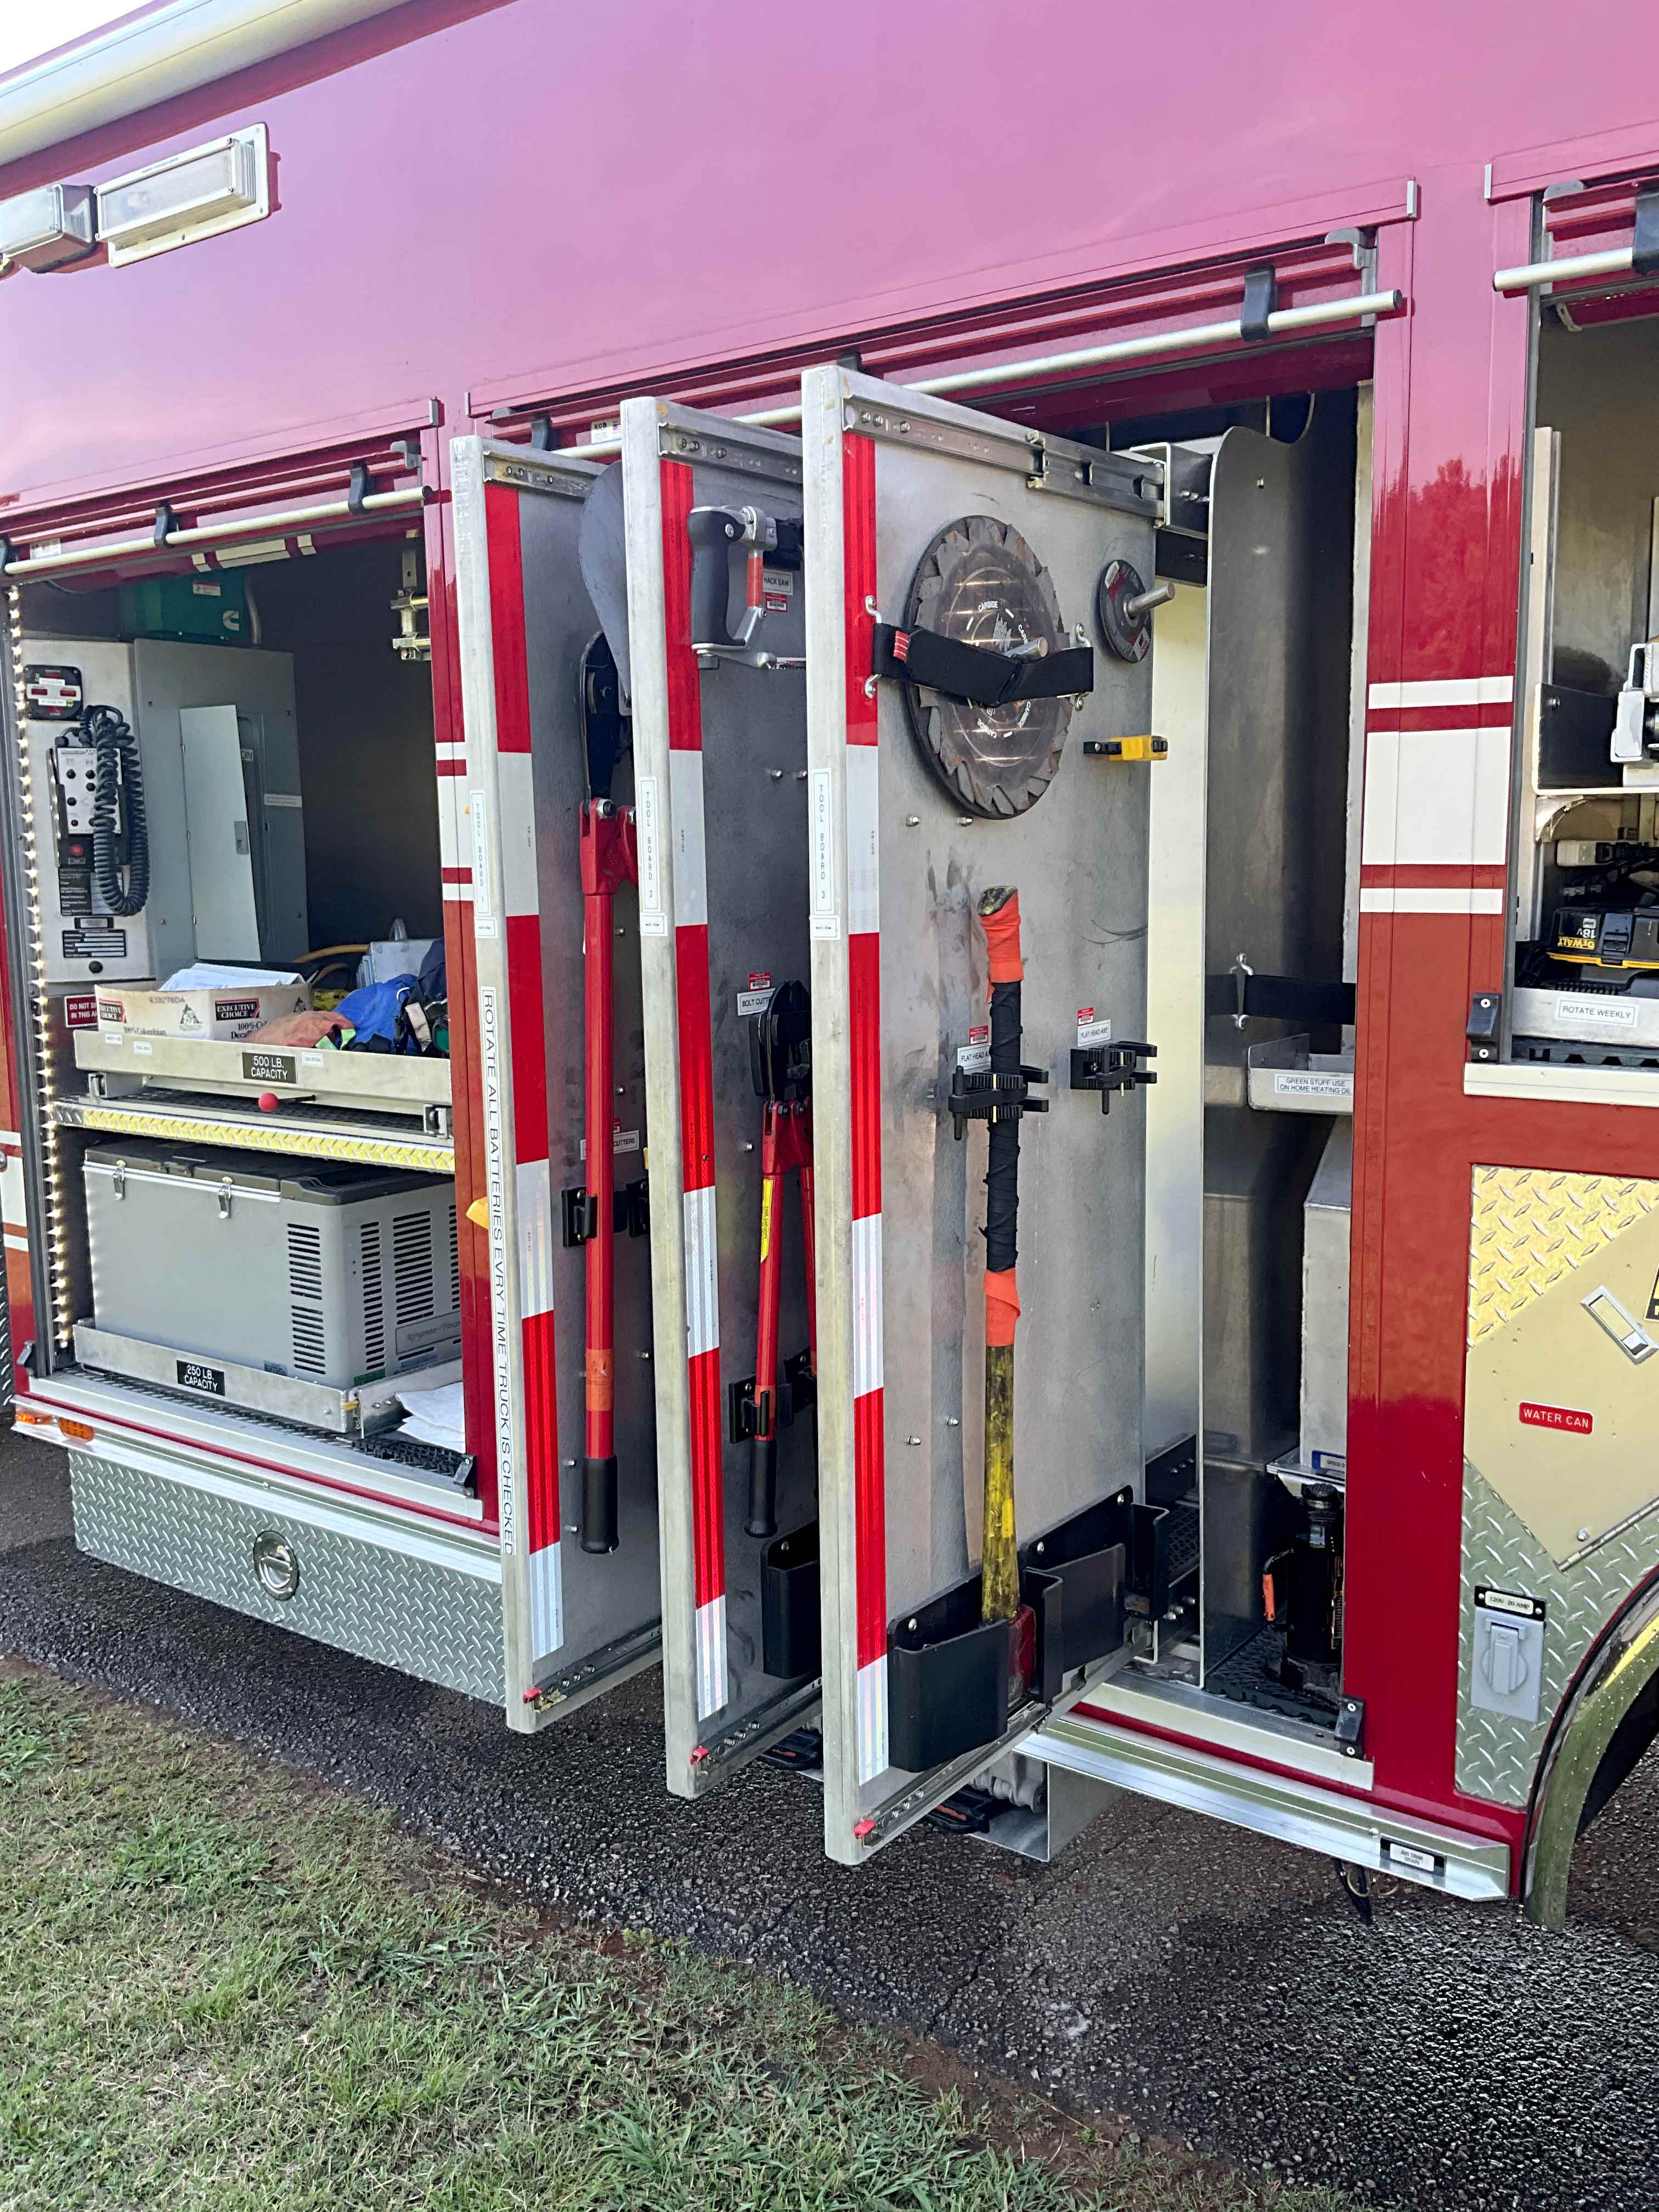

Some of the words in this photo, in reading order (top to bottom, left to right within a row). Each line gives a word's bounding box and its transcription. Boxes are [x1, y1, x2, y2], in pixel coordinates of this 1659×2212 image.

[764, 577, 777, 585] HACK
[978, 601, 998, 613] CARBIDE
[1018, 701, 1031, 729] CARBIDE
[977, 718, 997, 739] CARBIDE
[217, 1003, 256, 1012] EXECUTIVE
[755, 996, 771, 1005] CUTT
[221, 1011, 249, 1019] CHOICE
[1562, 1006, 1595, 1015] ROTATE
[1597, 1008, 1632, 1019] WEEKLY
[484, 995, 496, 1078] ROTATE
[253, 1056, 269, 1066] 500
[272, 1057, 284, 1069] LB.
[251, 1067, 287, 1080] CAPACITY
[488, 1085, 497, 1121] ALL
[613, 1137, 635, 1147] CUTTERS
[490, 1128, 502, 1240] BATTERIES
[494, 1247, 504, 1301] EVRY
[496, 1308, 507, 1355] TIME
[187, 1364, 201, 1377] 250
[202, 1370, 214, 1381] LB.
[184, 1375, 217, 1392] CAPACITY
[499, 1362, 510, 1430] TRUCK
[1523, 1408, 1562, 1423] WATER
[1566, 1415, 1589, 1429] CAN
[501, 1436, 510, 1454] IS
[503, 1460, 513, 1555] CHECKED
